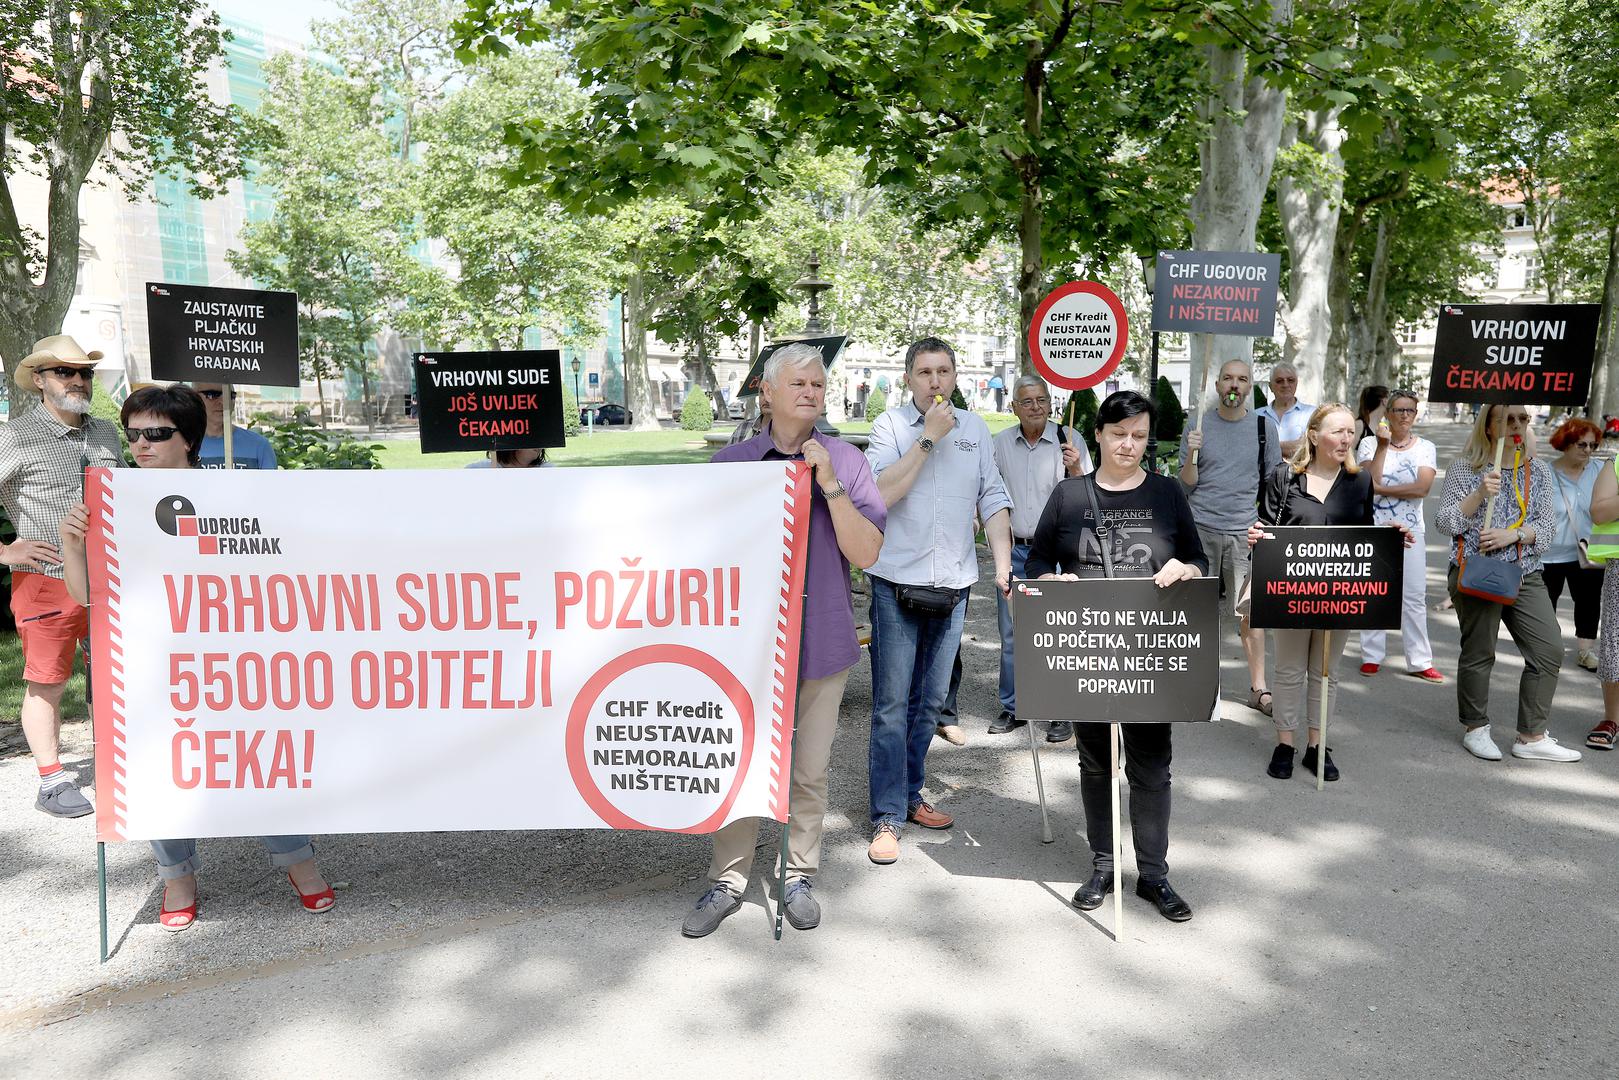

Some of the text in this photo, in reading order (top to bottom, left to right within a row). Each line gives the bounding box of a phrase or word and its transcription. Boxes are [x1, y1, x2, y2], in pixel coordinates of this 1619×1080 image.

[1169, 263, 1267, 282] CHF UGOVOR
[1172, 284, 1261, 302] NEZAKONIT
[184, 301, 264, 319] ZAUSTAVITE
[1050, 312, 1108, 322] CHF Kredit
[1169, 302, 1259, 323] I NIŠTETAN!
[194, 319, 256, 336] PLJAČKU
[1046, 325, 1111, 334] NEUSTAVAN
[1471, 320, 1566, 340] VRHOVNI
[188, 338, 264, 354] HRVATSKIH
[1044, 337, 1111, 347] NEMORALAN
[1049, 348, 1103, 359] NIŠTETAN
[1485, 346, 1544, 366] SUDE
[194, 356, 260, 372] GRAĐANA
[431, 369, 549, 387] VRHOVNI SUDE
[1446, 365, 1574, 391] ČEKAMO TE!
[448, 392, 538, 412] JOŠ UVIJEK
[458, 418, 530, 437] ČEKAMO!
[198, 517, 261, 535] UDRUGA
[219, 538, 282, 555] FRANAK
[1285, 543, 1374, 557] 6 GODINA OD
[1286, 562, 1371, 576] KONVERZIJE
[1266, 581, 1388, 596] NEMAMO PRAVNU
[163, 557, 740, 640] VRHOVNI SUDE, POŽURI!
[1288, 601, 1367, 614] SIGURNOST
[1046, 608, 1188, 626] ONO ŠTO NE VALJA
[1033, 630, 1201, 650] OD POČETKA, TIJEKOM
[1046, 653, 1188, 671] VREMENA NEĆE SE
[170, 650, 552, 711] 55000 OBITELJI
[1078, 679, 1155, 694] POPRAVITI
[605, 700, 723, 719] CHF Kredit
[596, 725, 733, 744] NEUSTAVAN
[171, 718, 315, 790] ČEKA!
[593, 750, 736, 769] NEMORALAN
[611, 769, 720, 793] NIŠTETAN
